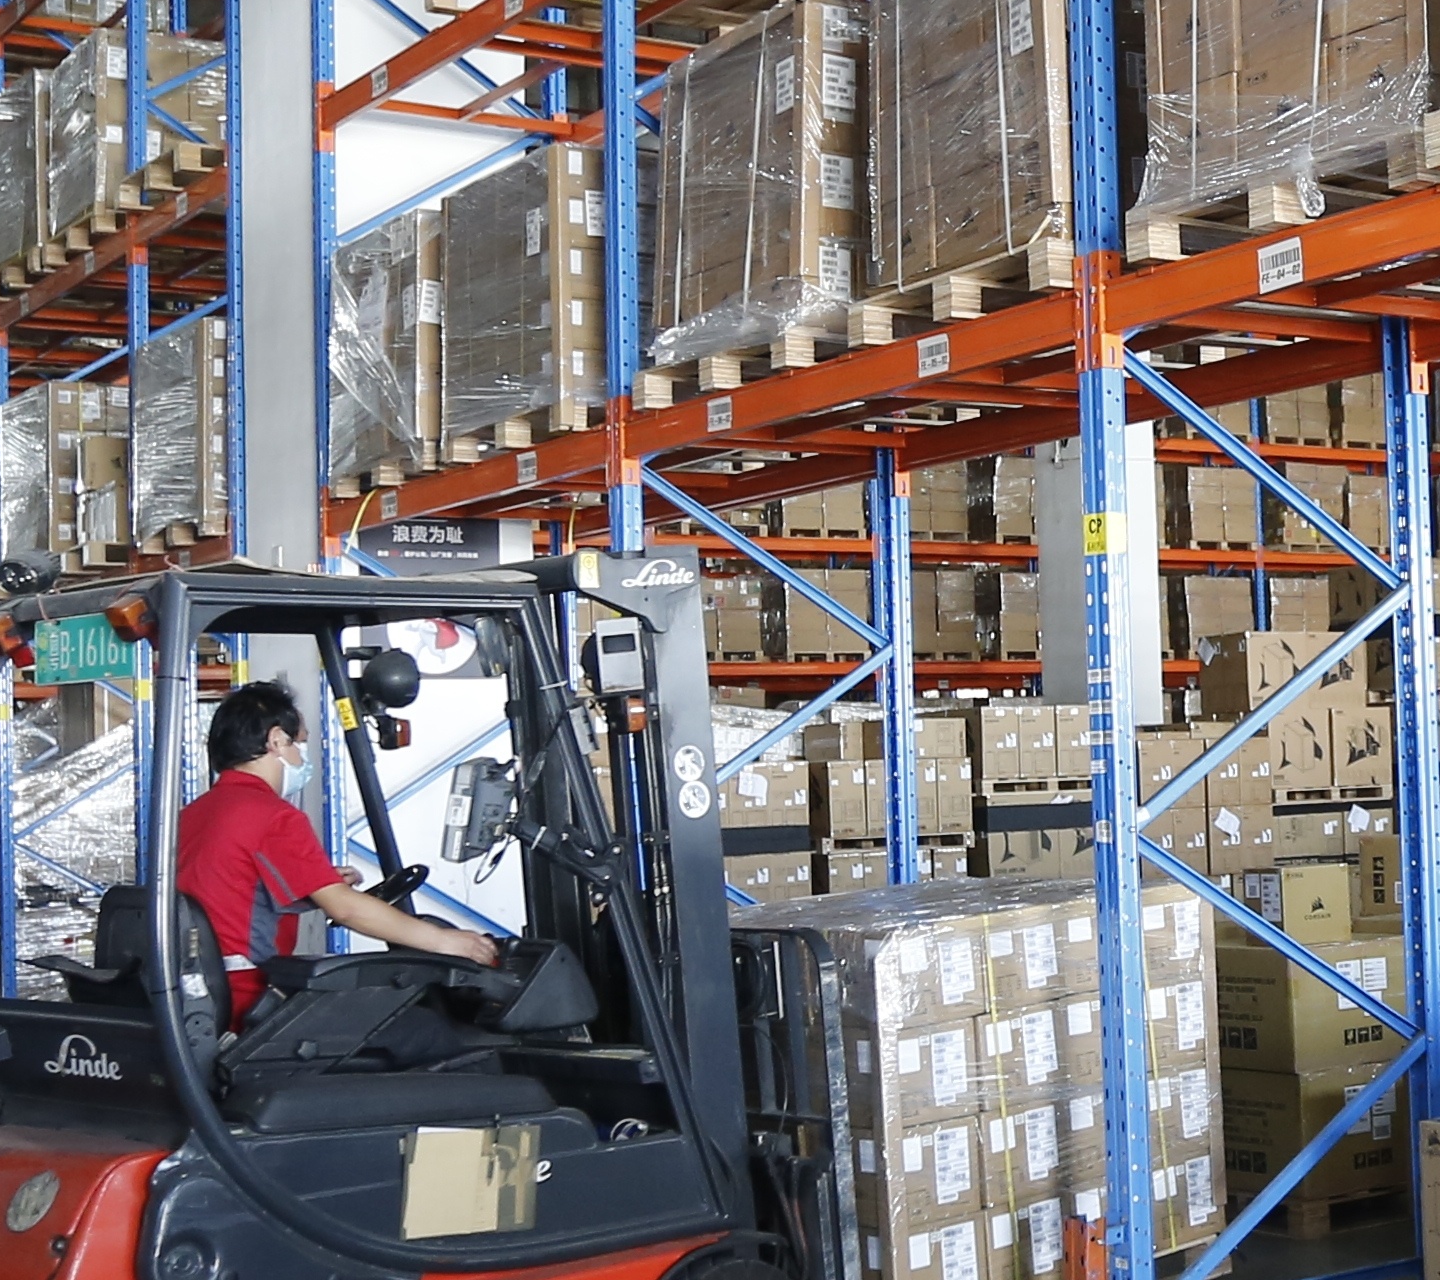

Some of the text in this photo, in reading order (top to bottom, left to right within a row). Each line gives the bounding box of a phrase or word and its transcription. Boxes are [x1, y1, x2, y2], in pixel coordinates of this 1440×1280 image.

[1261, 262, 1300, 284] FE-04-02
[392, 524, 464, 544] 浪费为耻
[1088, 518, 1103, 534] CP
[621, 558, 695, 589] Linde
[44, 1035, 122, 1081] Linde
